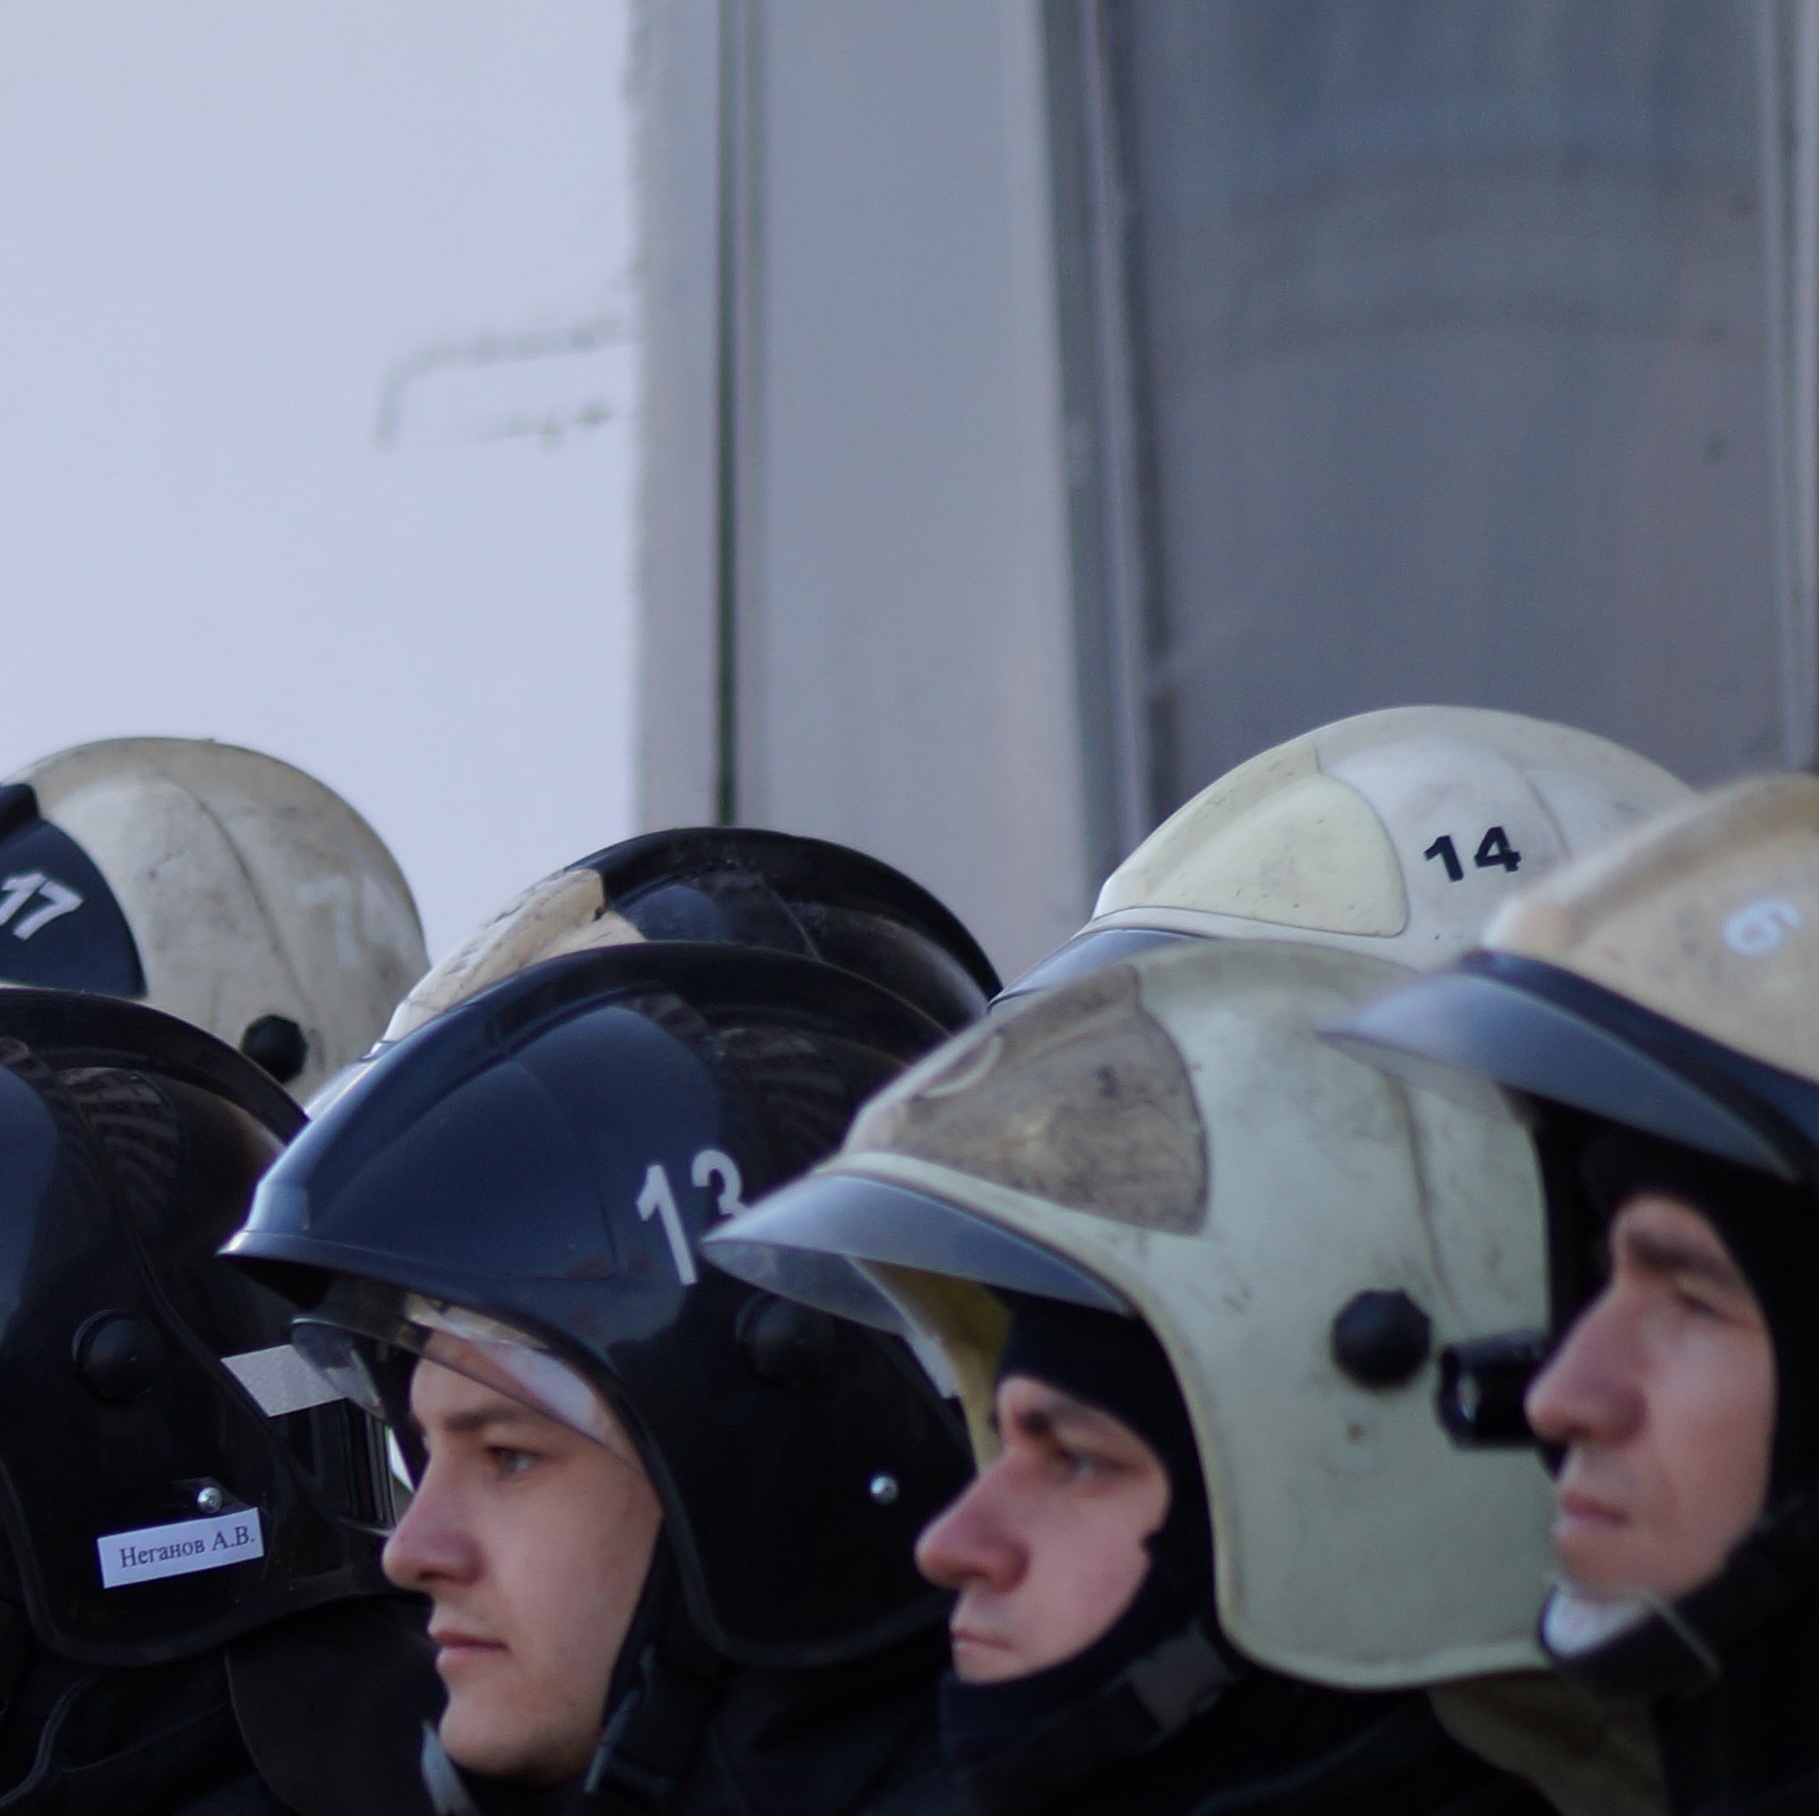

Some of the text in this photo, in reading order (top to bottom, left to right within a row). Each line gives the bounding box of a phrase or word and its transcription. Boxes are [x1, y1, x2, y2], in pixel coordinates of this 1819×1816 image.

[1423, 826, 1522, 882] 14
[119, 1525, 256, 1569] Неганов А.В.
